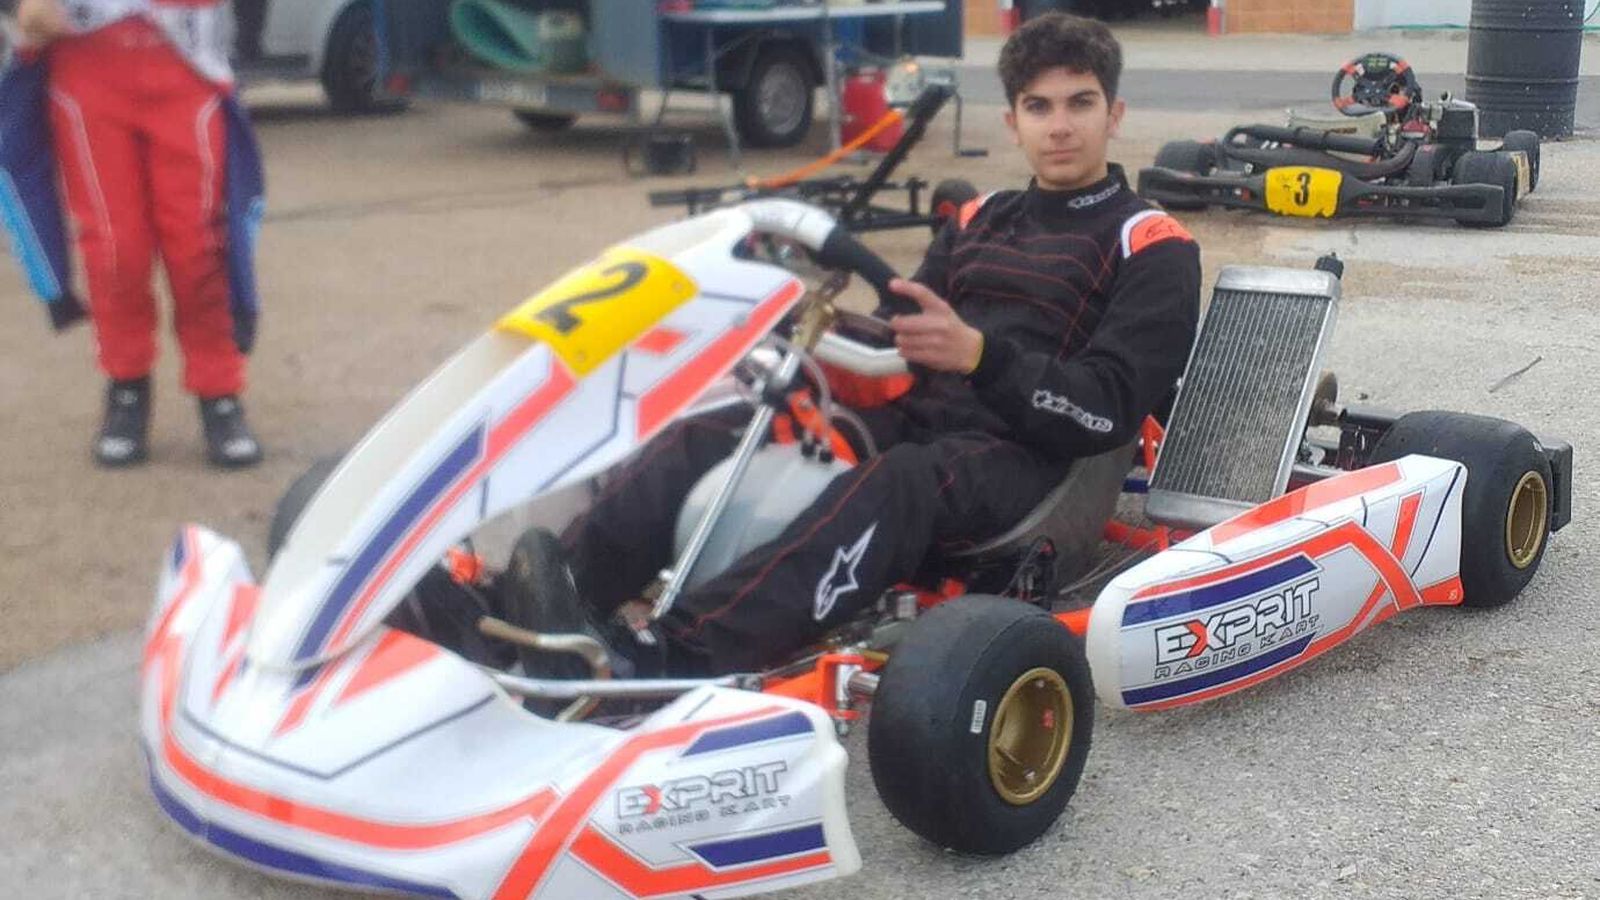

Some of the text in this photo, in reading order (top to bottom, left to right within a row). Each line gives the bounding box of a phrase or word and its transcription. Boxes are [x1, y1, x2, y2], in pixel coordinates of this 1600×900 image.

[1294, 172, 1311, 207] 3
[534, 262, 648, 335] 2
[1154, 614, 1320, 679] RACING KART
[1155, 577, 1320, 665] EXPRIT
[617, 760, 787, 819] EXPRIT
[618, 794, 791, 834] RACING KART
